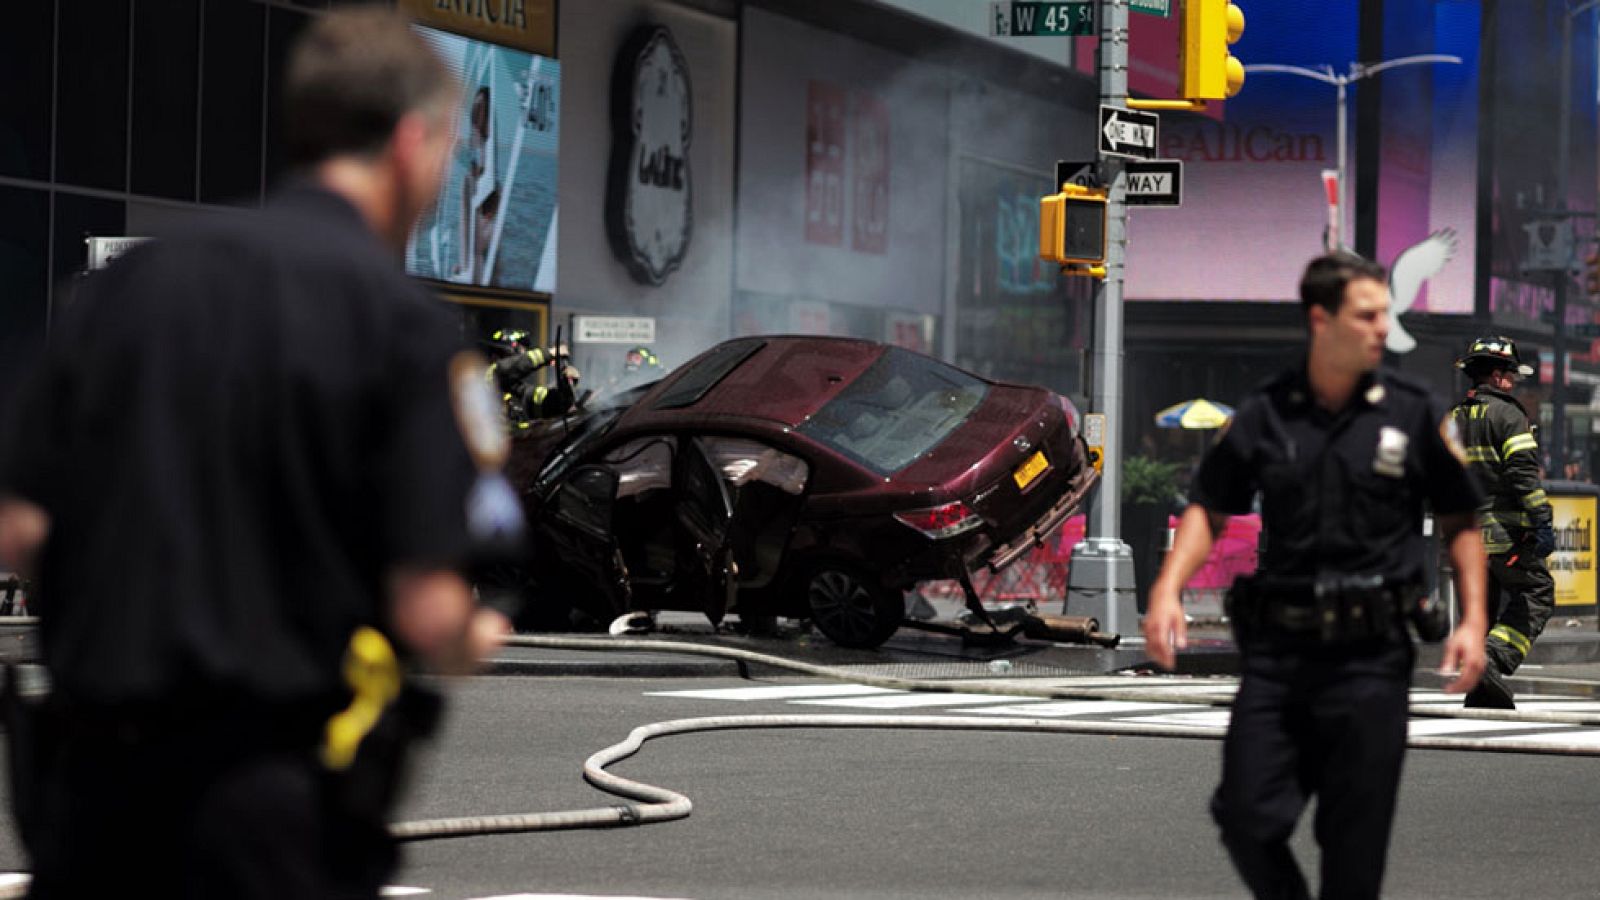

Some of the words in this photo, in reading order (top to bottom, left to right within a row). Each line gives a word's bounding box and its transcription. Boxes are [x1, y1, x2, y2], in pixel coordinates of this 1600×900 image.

[1016, 6, 1036, 32] W
[1044, 5, 1070, 32] 45
[1109, 121, 1126, 142] ONE
[1163, 121, 1326, 162] eAllCan
[1075, 174, 1098, 188] ON
[1127, 175, 1164, 192] WAY
